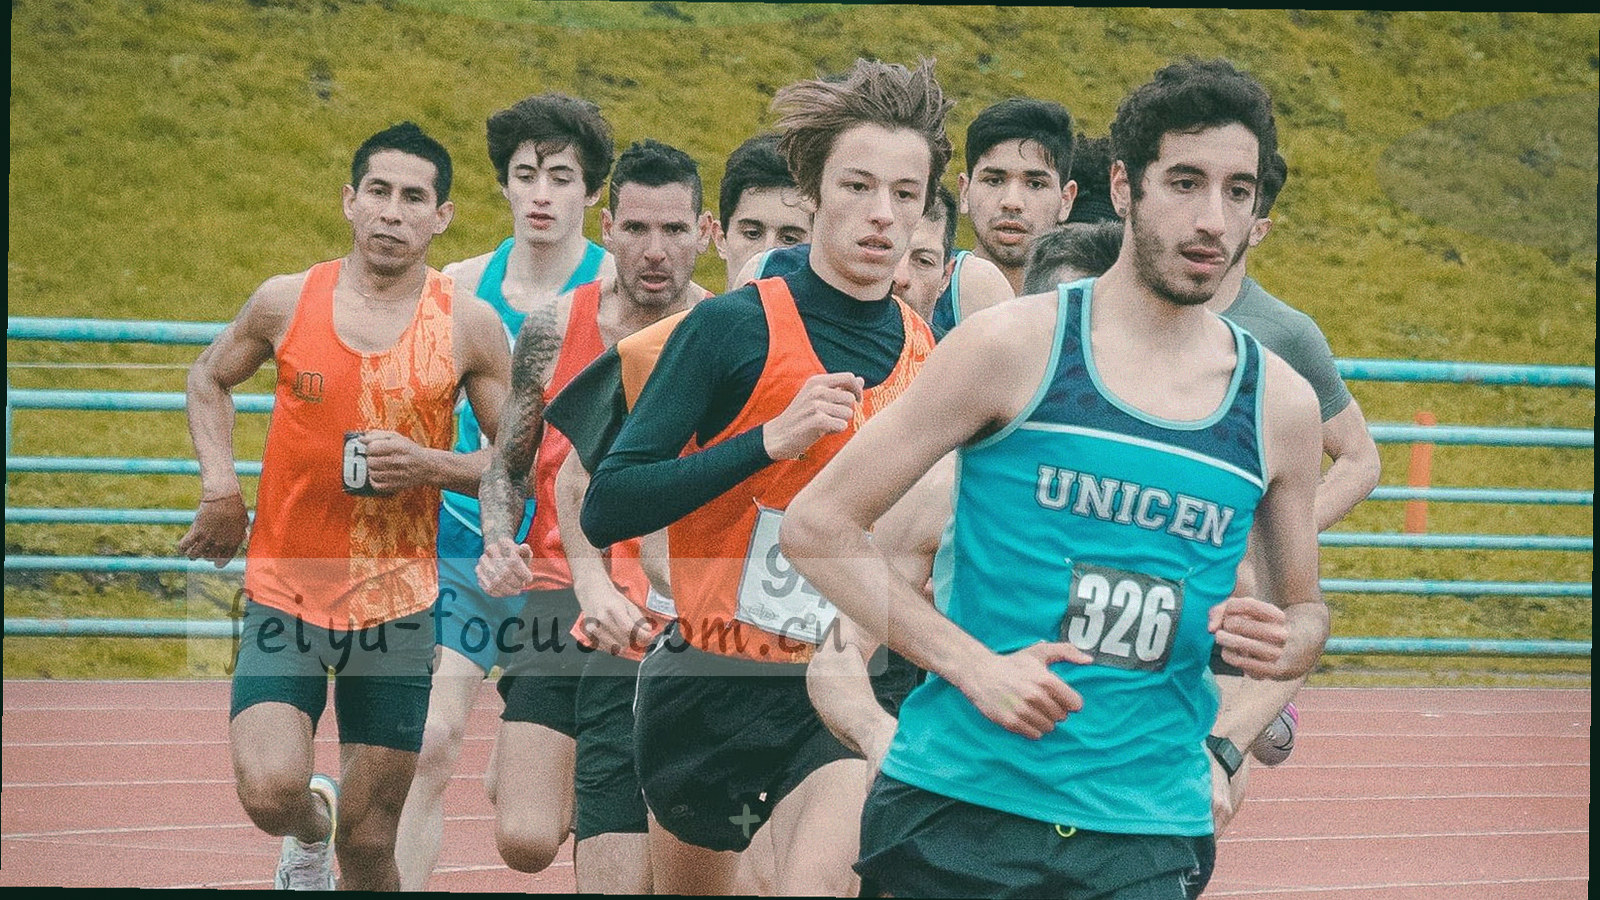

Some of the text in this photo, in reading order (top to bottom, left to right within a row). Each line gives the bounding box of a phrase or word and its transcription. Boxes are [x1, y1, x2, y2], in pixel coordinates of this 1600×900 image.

[1036, 464, 1235, 547] UNICEN
[761, 543, 828, 609] 9
[1068, 573, 1176, 662] 326
